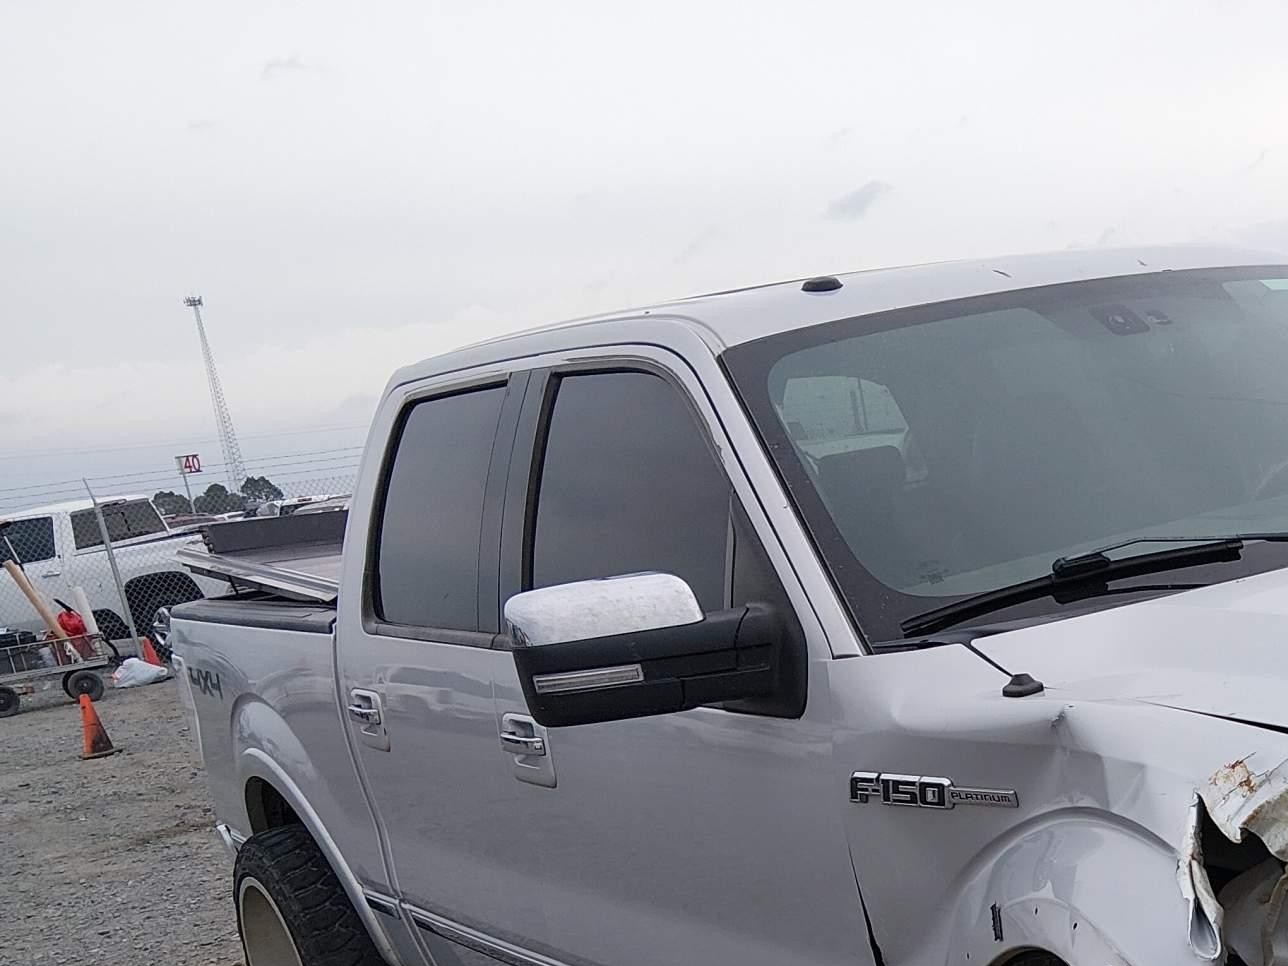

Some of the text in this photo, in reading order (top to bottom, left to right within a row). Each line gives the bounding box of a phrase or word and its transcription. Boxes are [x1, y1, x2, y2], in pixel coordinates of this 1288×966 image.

[184, 455, 201, 473] 40
[187, 666, 224, 700] 4X4
[850, 771, 1011, 809] F-150 PLATINUM
